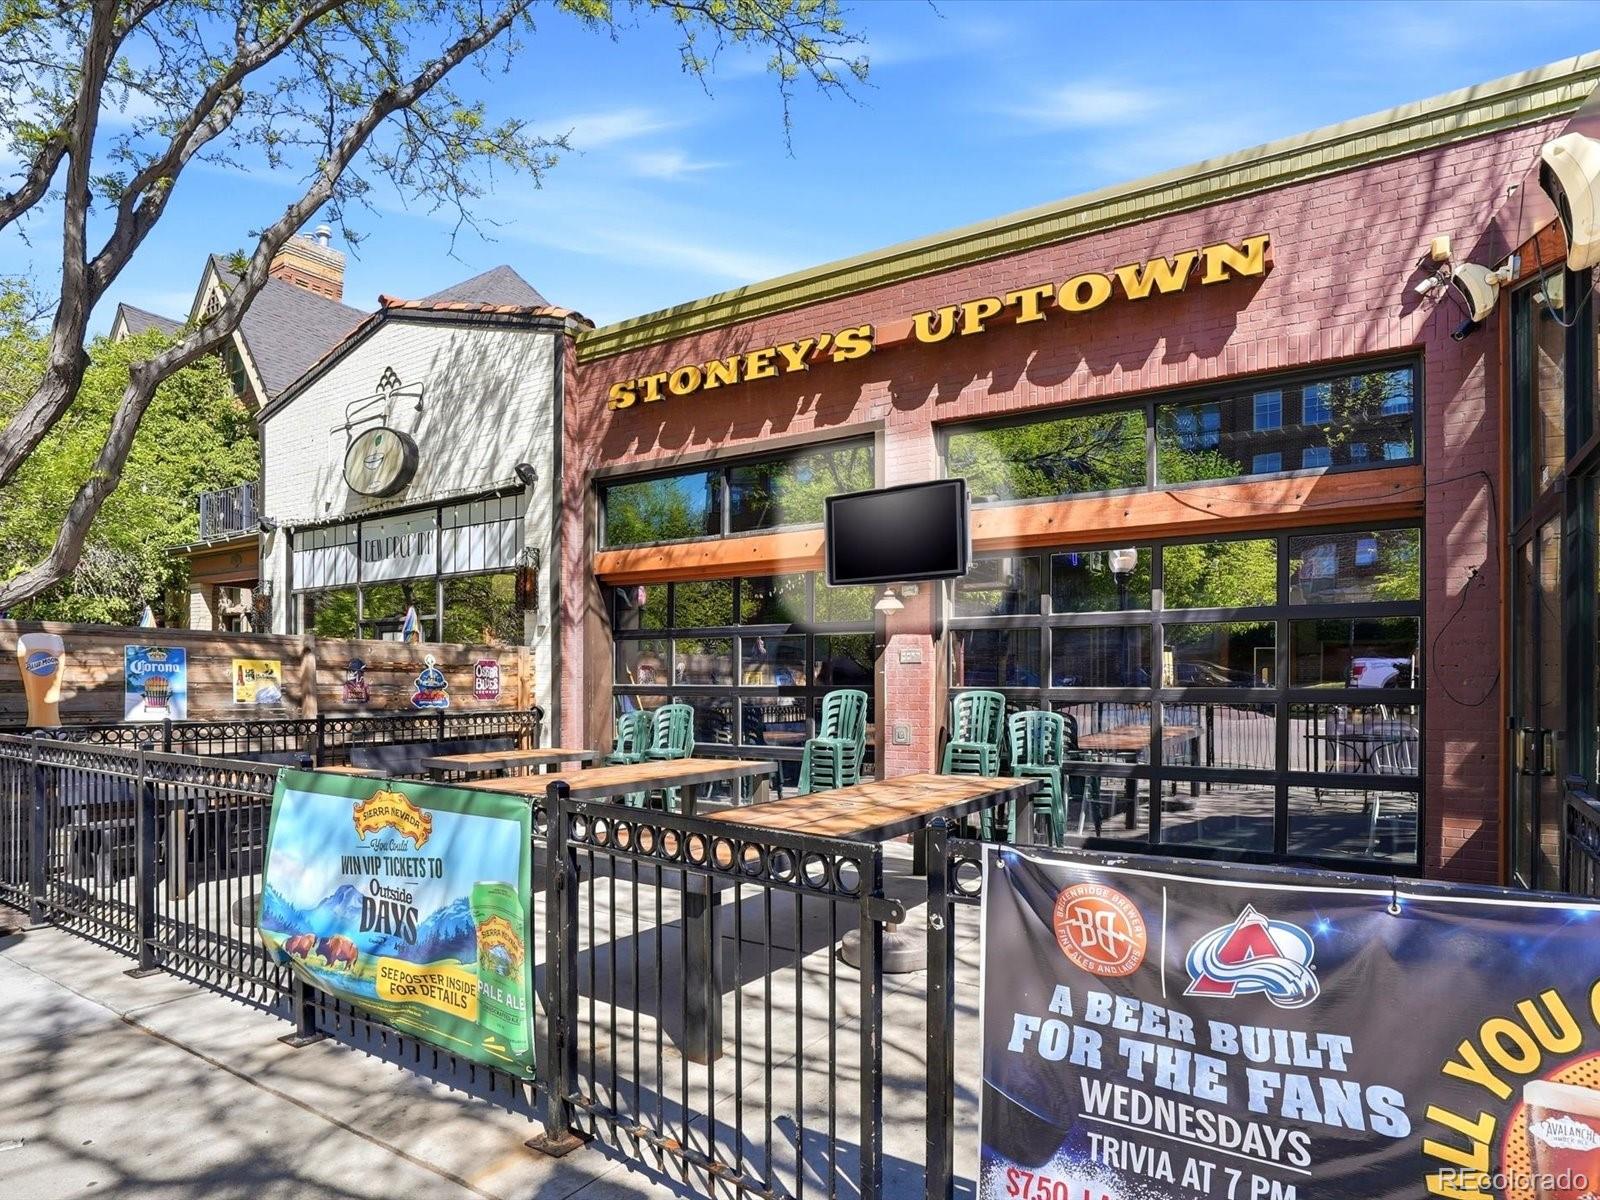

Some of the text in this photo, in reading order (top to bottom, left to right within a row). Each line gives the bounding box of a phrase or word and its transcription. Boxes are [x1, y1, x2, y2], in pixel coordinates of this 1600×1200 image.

[608, 233, 1272, 411] STONEY'S UPTOWN
[130, 659, 180, 675] Corona
[363, 806, 420, 829] SIERRA NEVADA
[341, 855, 443, 879] WIN VIP TICKETS TO
[389, 838, 409, 852] Could
[369, 878, 413, 904] Outside
[359, 895, 418, 945] DAYS
[1111, 894, 1144, 939] BREWERY
[1058, 928, 1074, 951] FINE
[1071, 951, 1095, 970] ALES
[1097, 965, 1118, 975] AND
[381, 966, 477, 997] SEE POSTER INSIDE
[390, 982, 418, 996] FOR
[420, 984, 467, 1010] DETAILS
[477, 979, 526, 1011] PALE ALE
[1048, 984, 1353, 1072] A BEER BUILT
[1441, 989, 1583, 1101] YOU
[1007, 1012, 1412, 1138] FOR THE FANS
[1079, 1075, 1312, 1168] WEDNESDAYS
[1087, 1131, 1297, 1200] TRIVIA AT 7 PM
